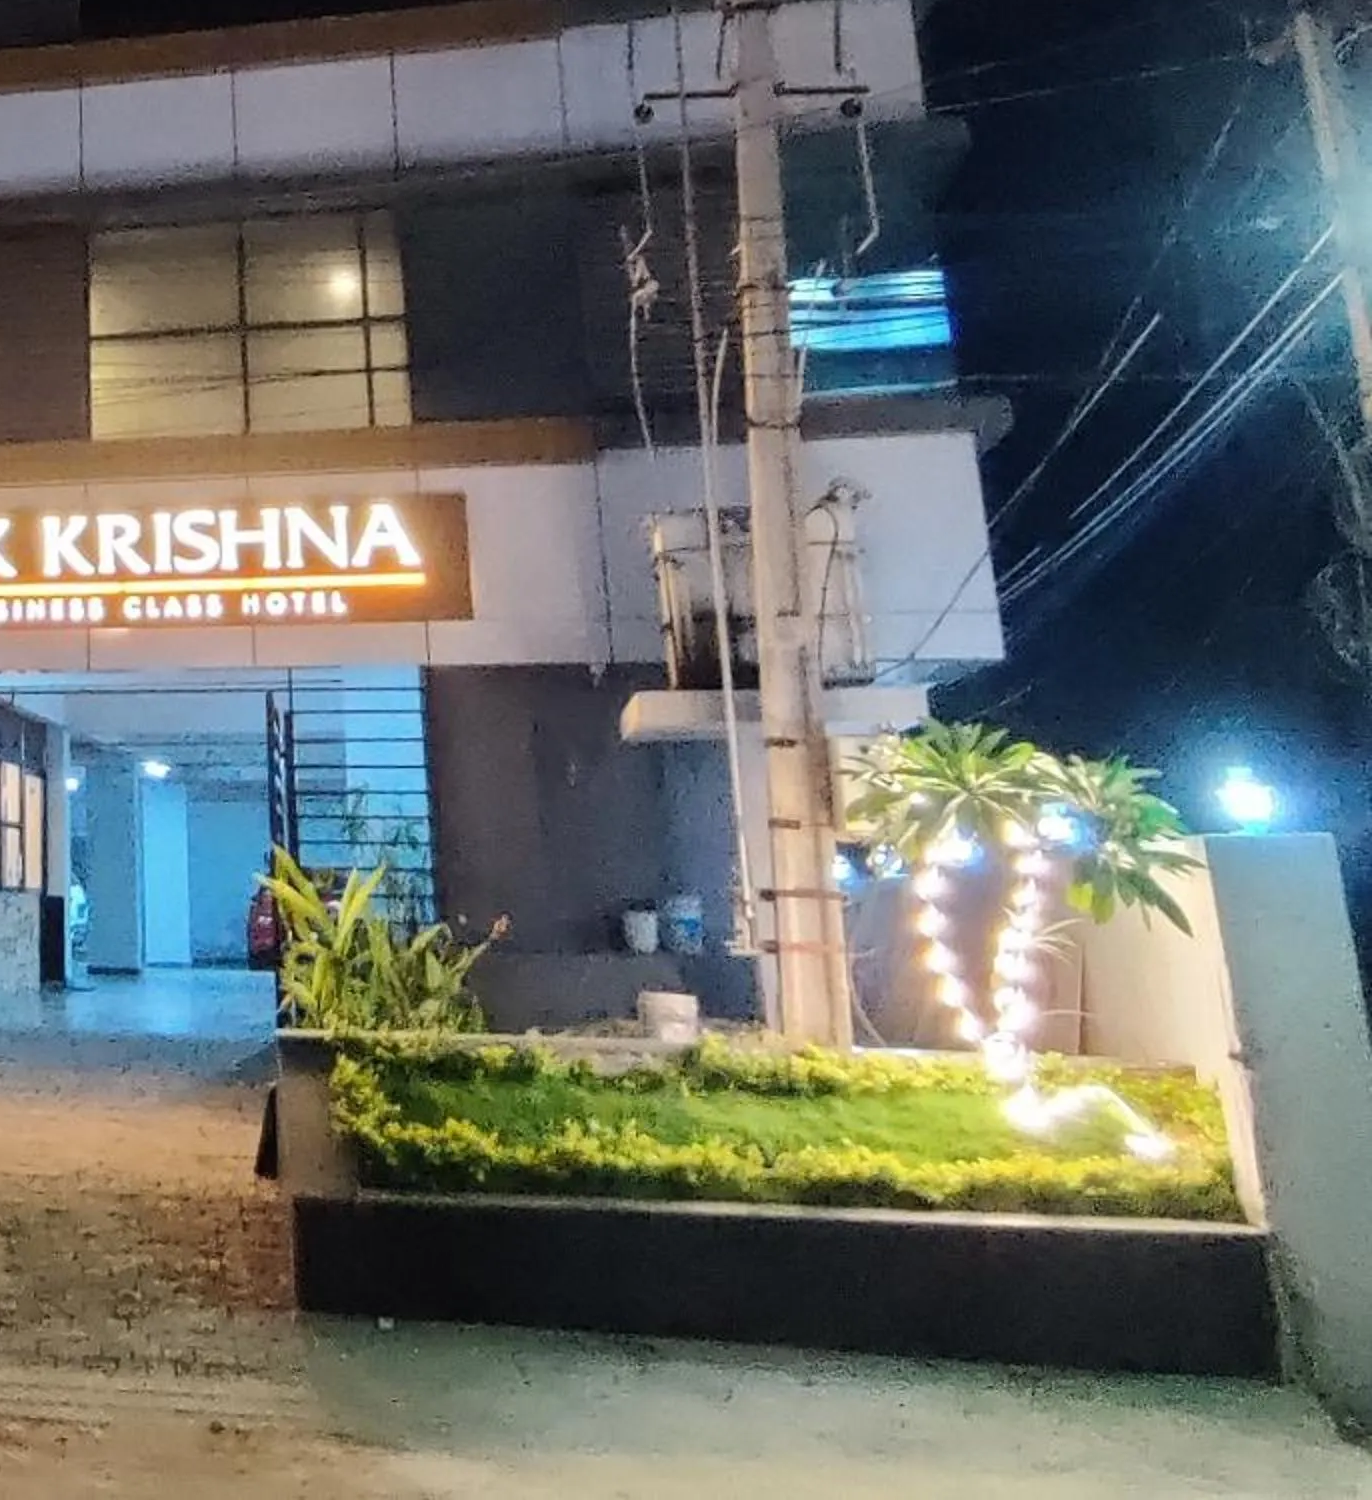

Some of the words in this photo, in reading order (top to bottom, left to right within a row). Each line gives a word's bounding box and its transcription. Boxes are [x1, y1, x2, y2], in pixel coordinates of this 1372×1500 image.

[41, 503, 423, 577] KRISHNA
[122, 593, 224, 620] CLASS
[242, 588, 348, 615] HOTEL
